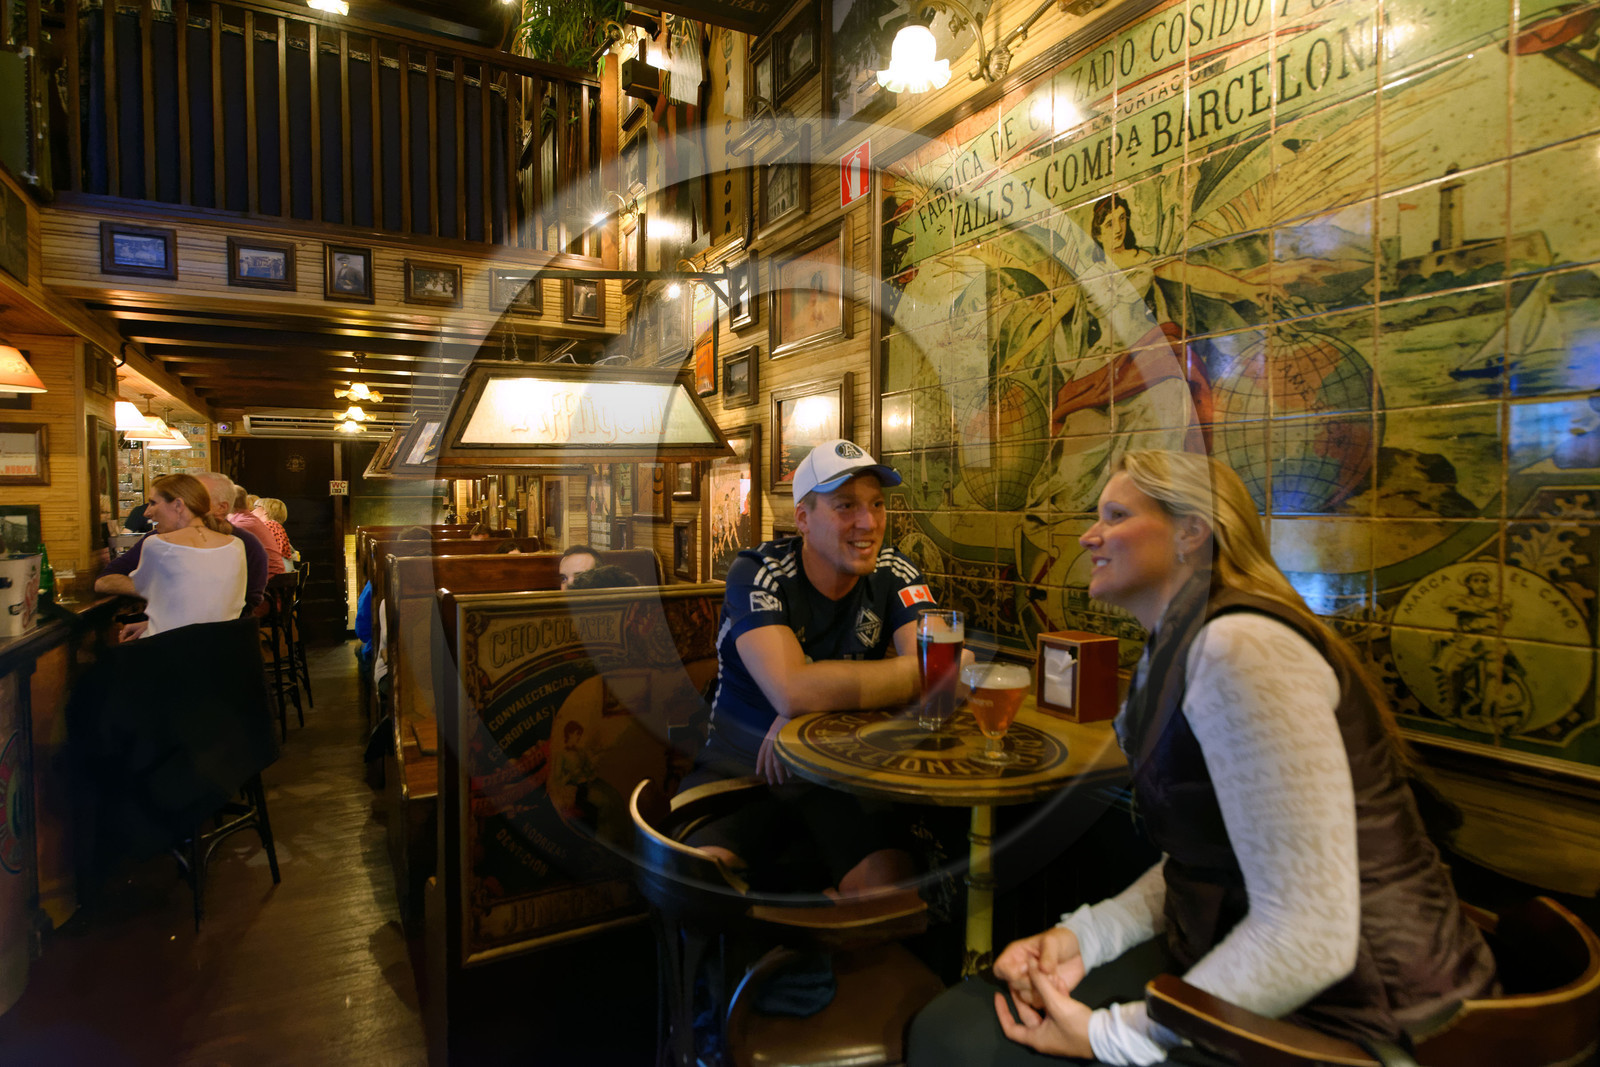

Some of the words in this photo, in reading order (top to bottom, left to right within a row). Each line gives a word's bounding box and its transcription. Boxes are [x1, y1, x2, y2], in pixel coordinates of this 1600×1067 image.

[990, 117, 1019, 162] DE
[1028, 38, 1135, 132] CZADO
[948, 180, 1014, 239] VALLS
[1021, 177, 1036, 210] Y
[1403, 574, 1451, 615] MARCA
[1510, 571, 1529, 588] EL
[489, 615, 617, 669] CHOCOLATE
